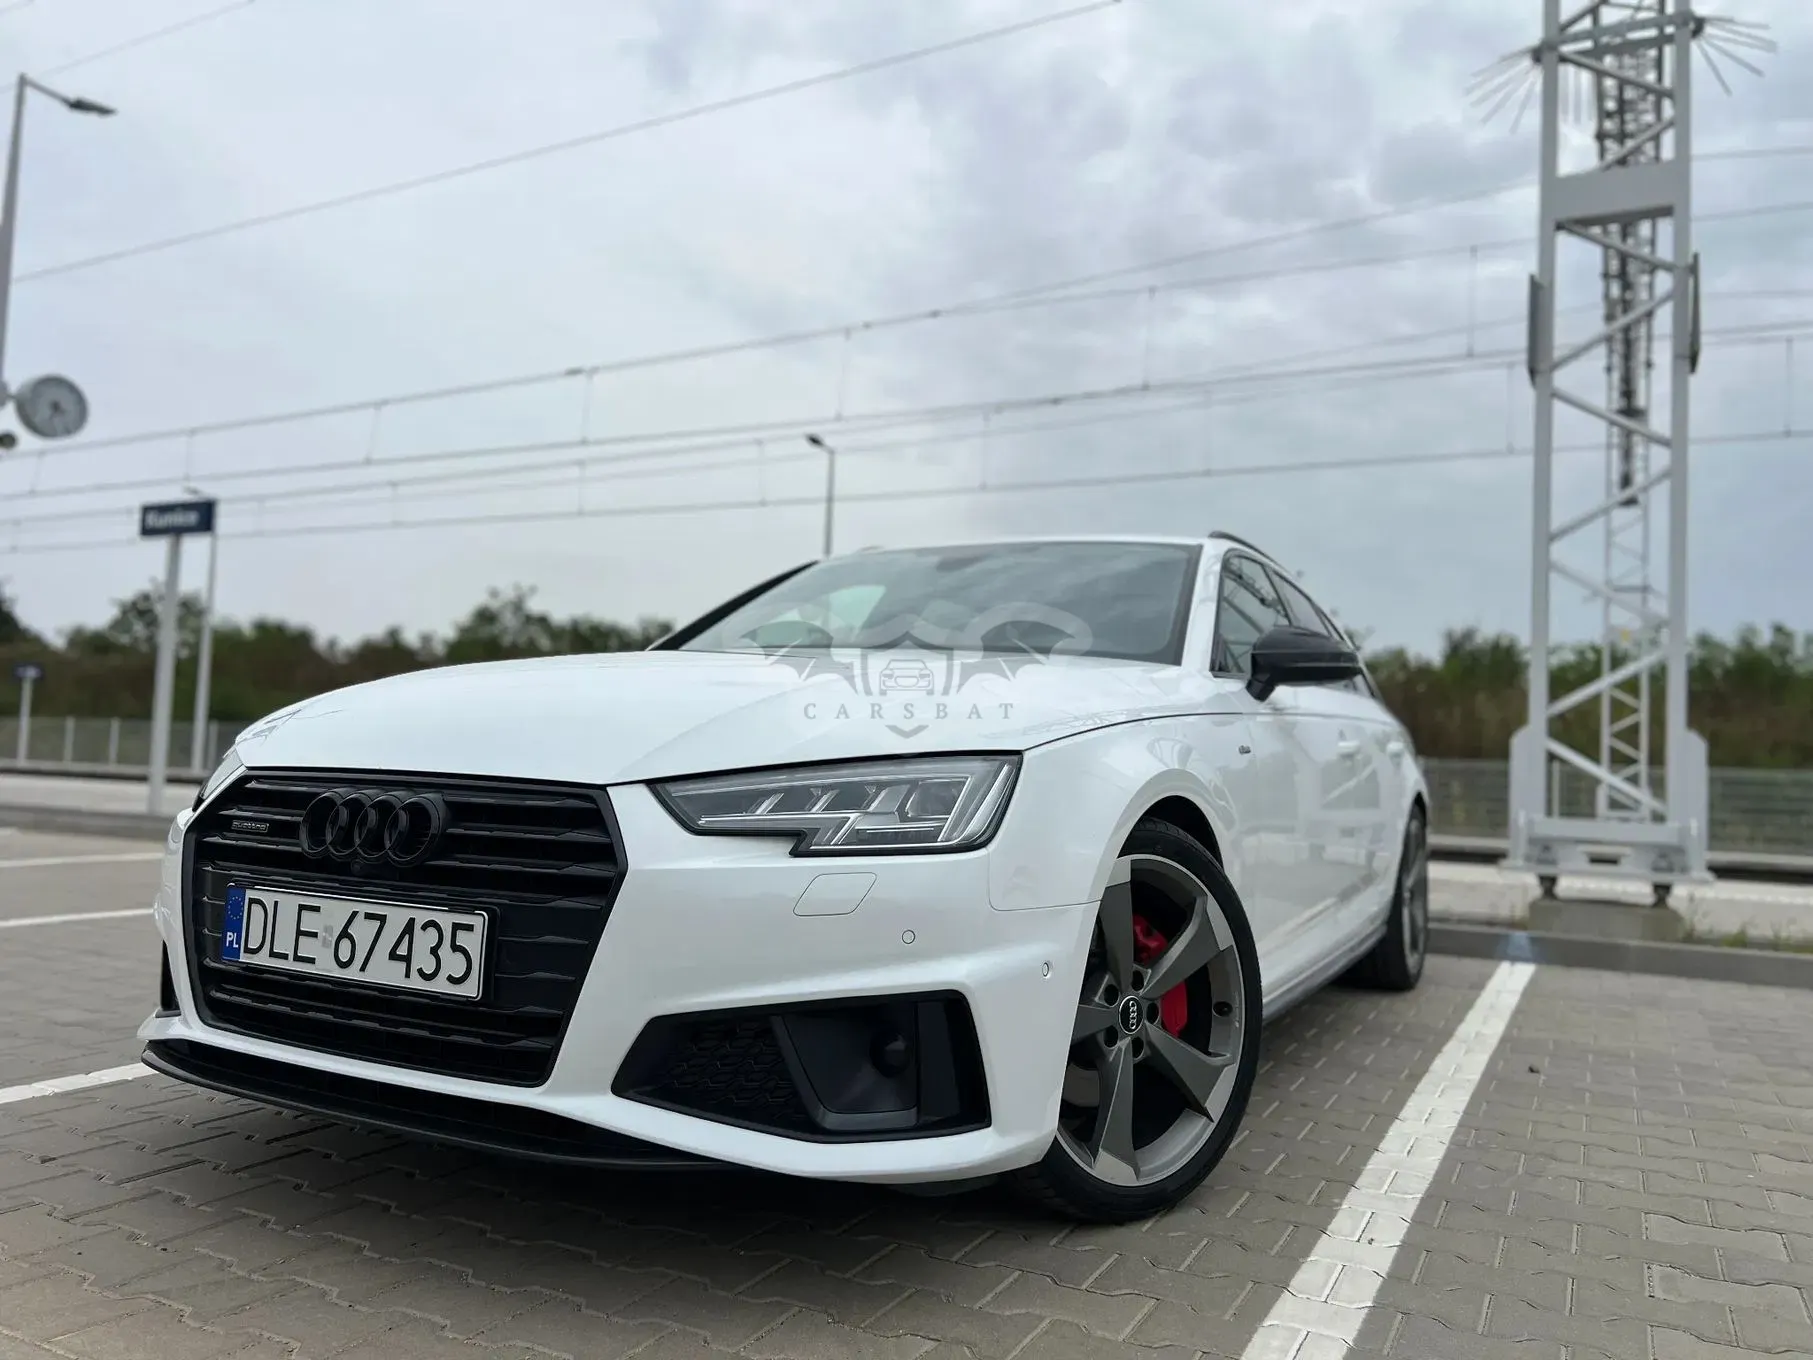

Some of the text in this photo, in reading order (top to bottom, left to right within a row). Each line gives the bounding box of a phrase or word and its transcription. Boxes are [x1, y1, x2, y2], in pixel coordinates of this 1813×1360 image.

[226, 931, 239, 948] PL
[243, 896, 475, 985] DLE 67435
